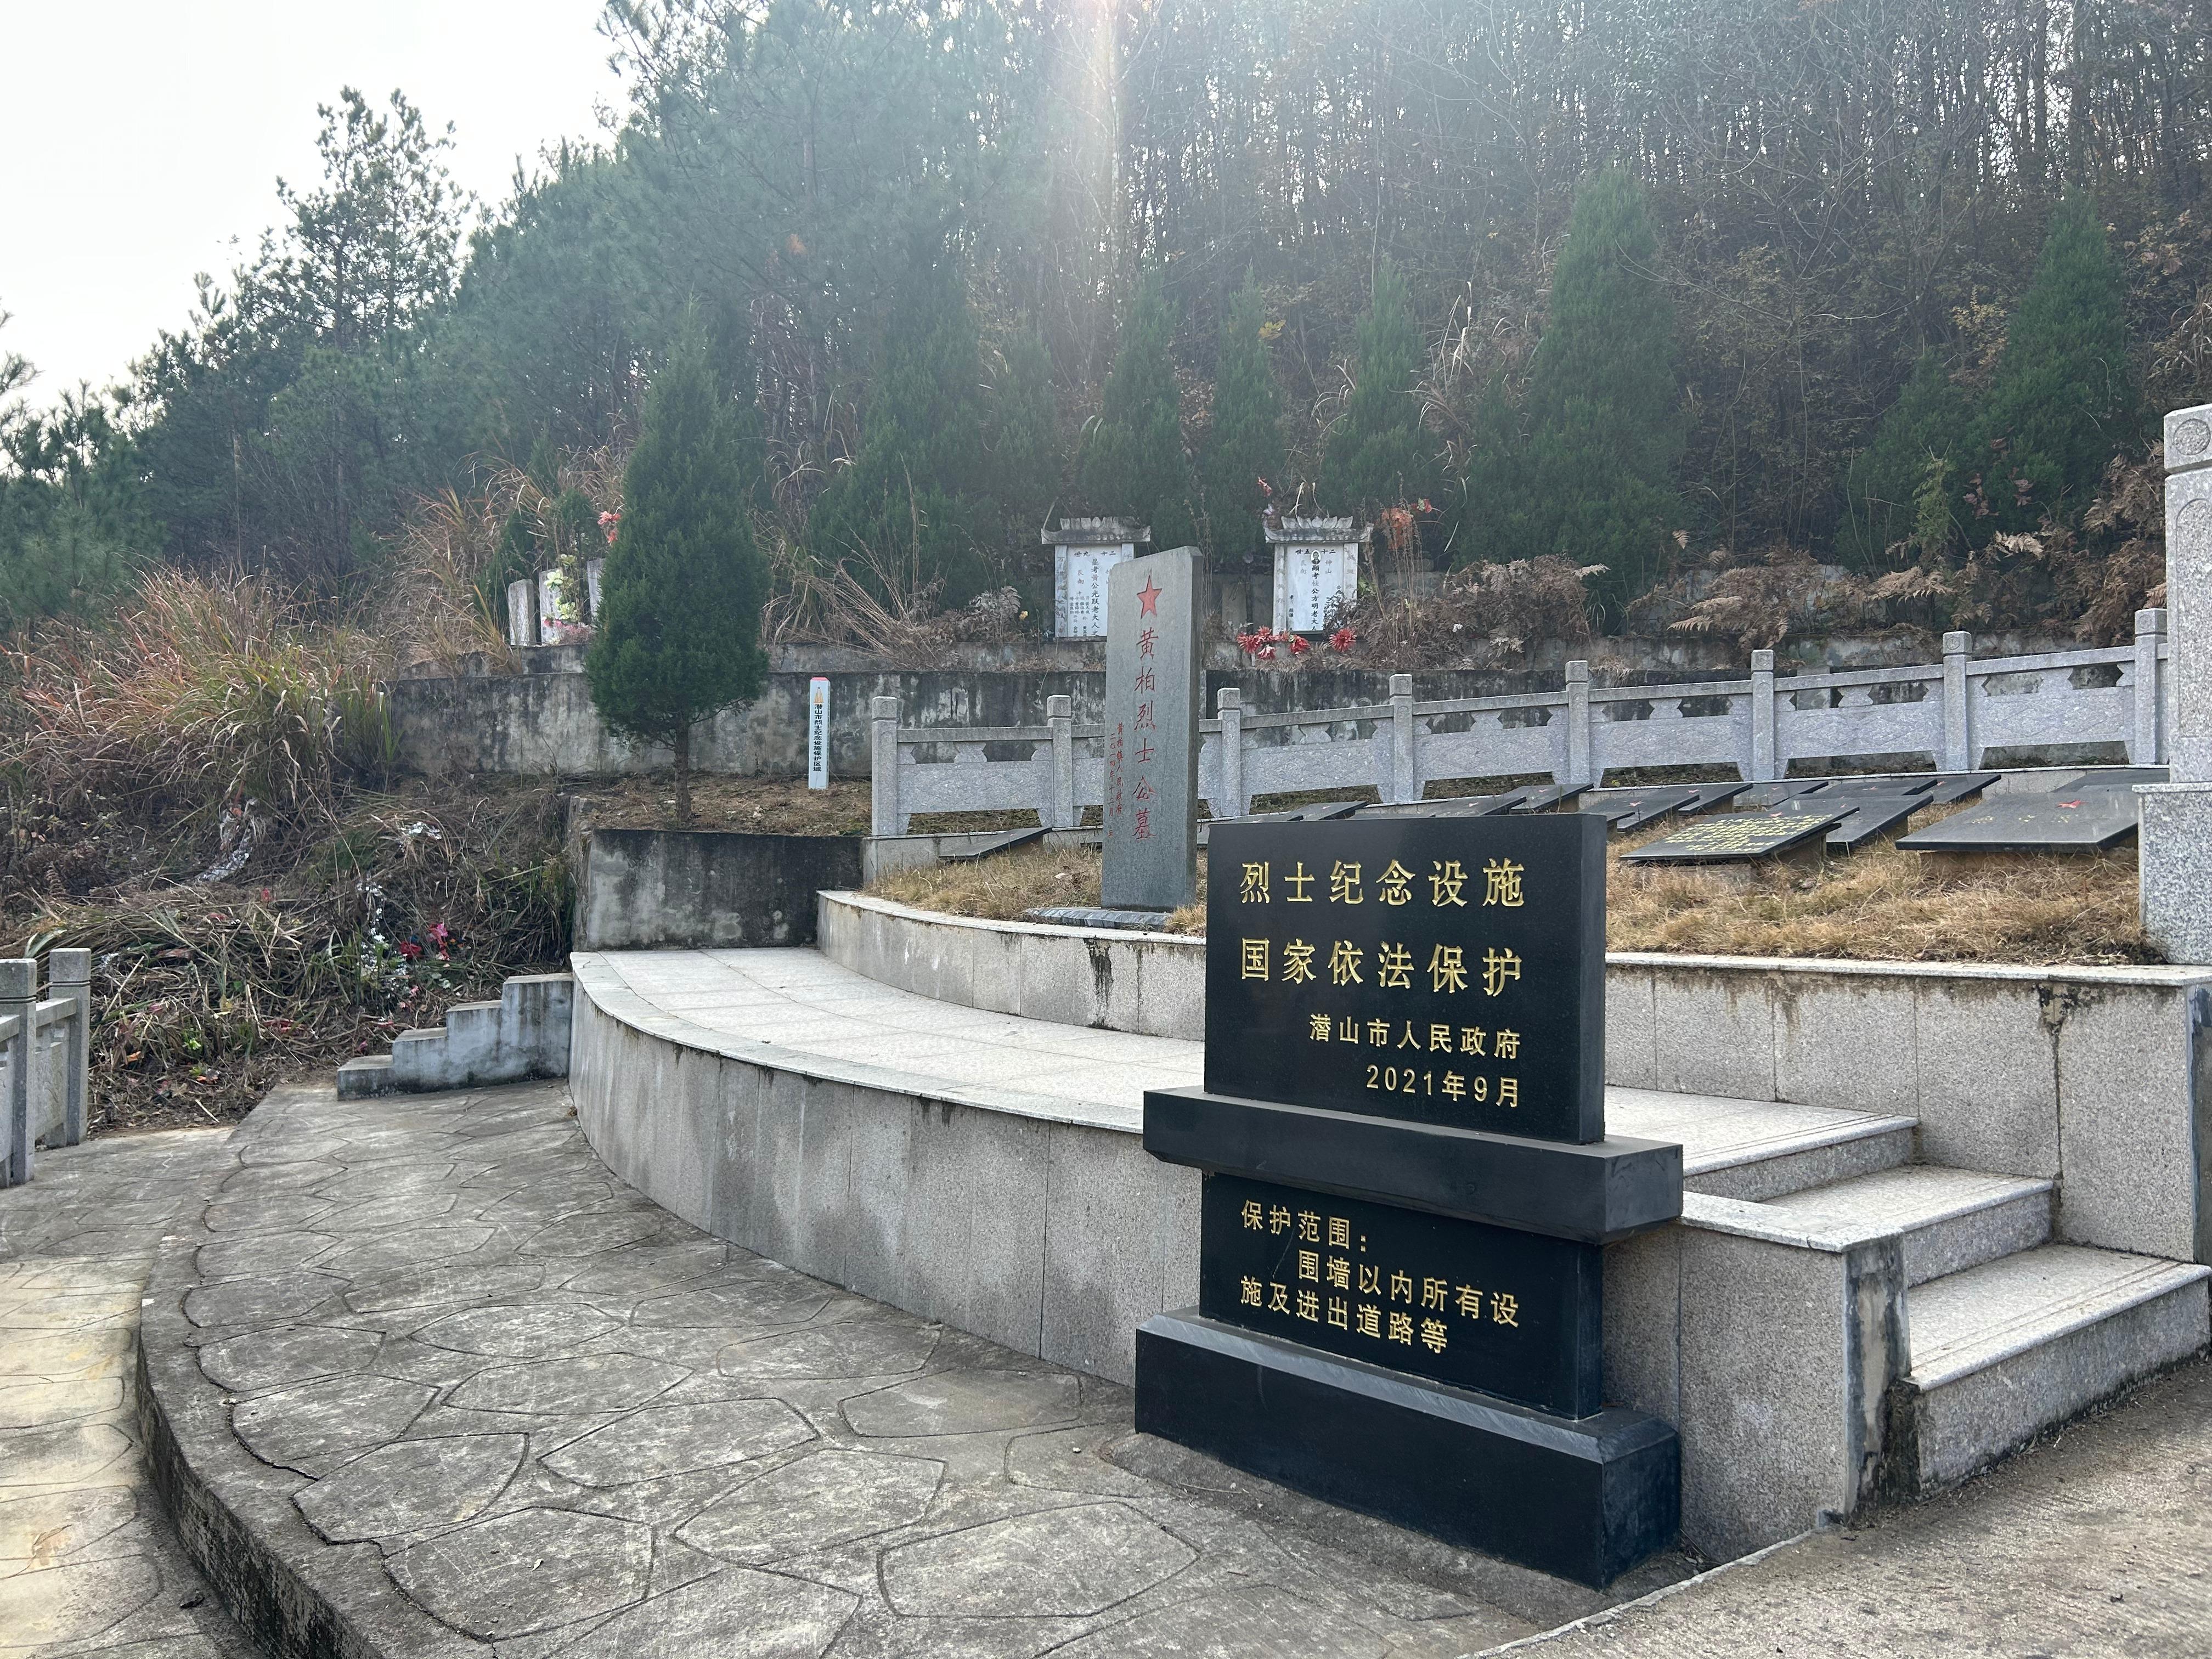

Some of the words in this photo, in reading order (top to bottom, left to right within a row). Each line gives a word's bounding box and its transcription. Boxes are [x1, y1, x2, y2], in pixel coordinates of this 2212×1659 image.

[813, 703, 823, 772] 潜山市烈士纪念设施保护区域
[1132, 628, 1159, 840] 黄柏烈士公墓
[1240, 857, 1525, 907] 烈士纪念设施
[1241, 937, 1522, 997] 国家依法保护
[1309, 1013, 1520, 1060] 潜山市人民政府
[1366, 1064, 1519, 1108] 2021年9月
[1240, 1275, 1448, 1355] 施及进出道路等
[1298, 1249, 1519, 1328] 围墙以内所有设
